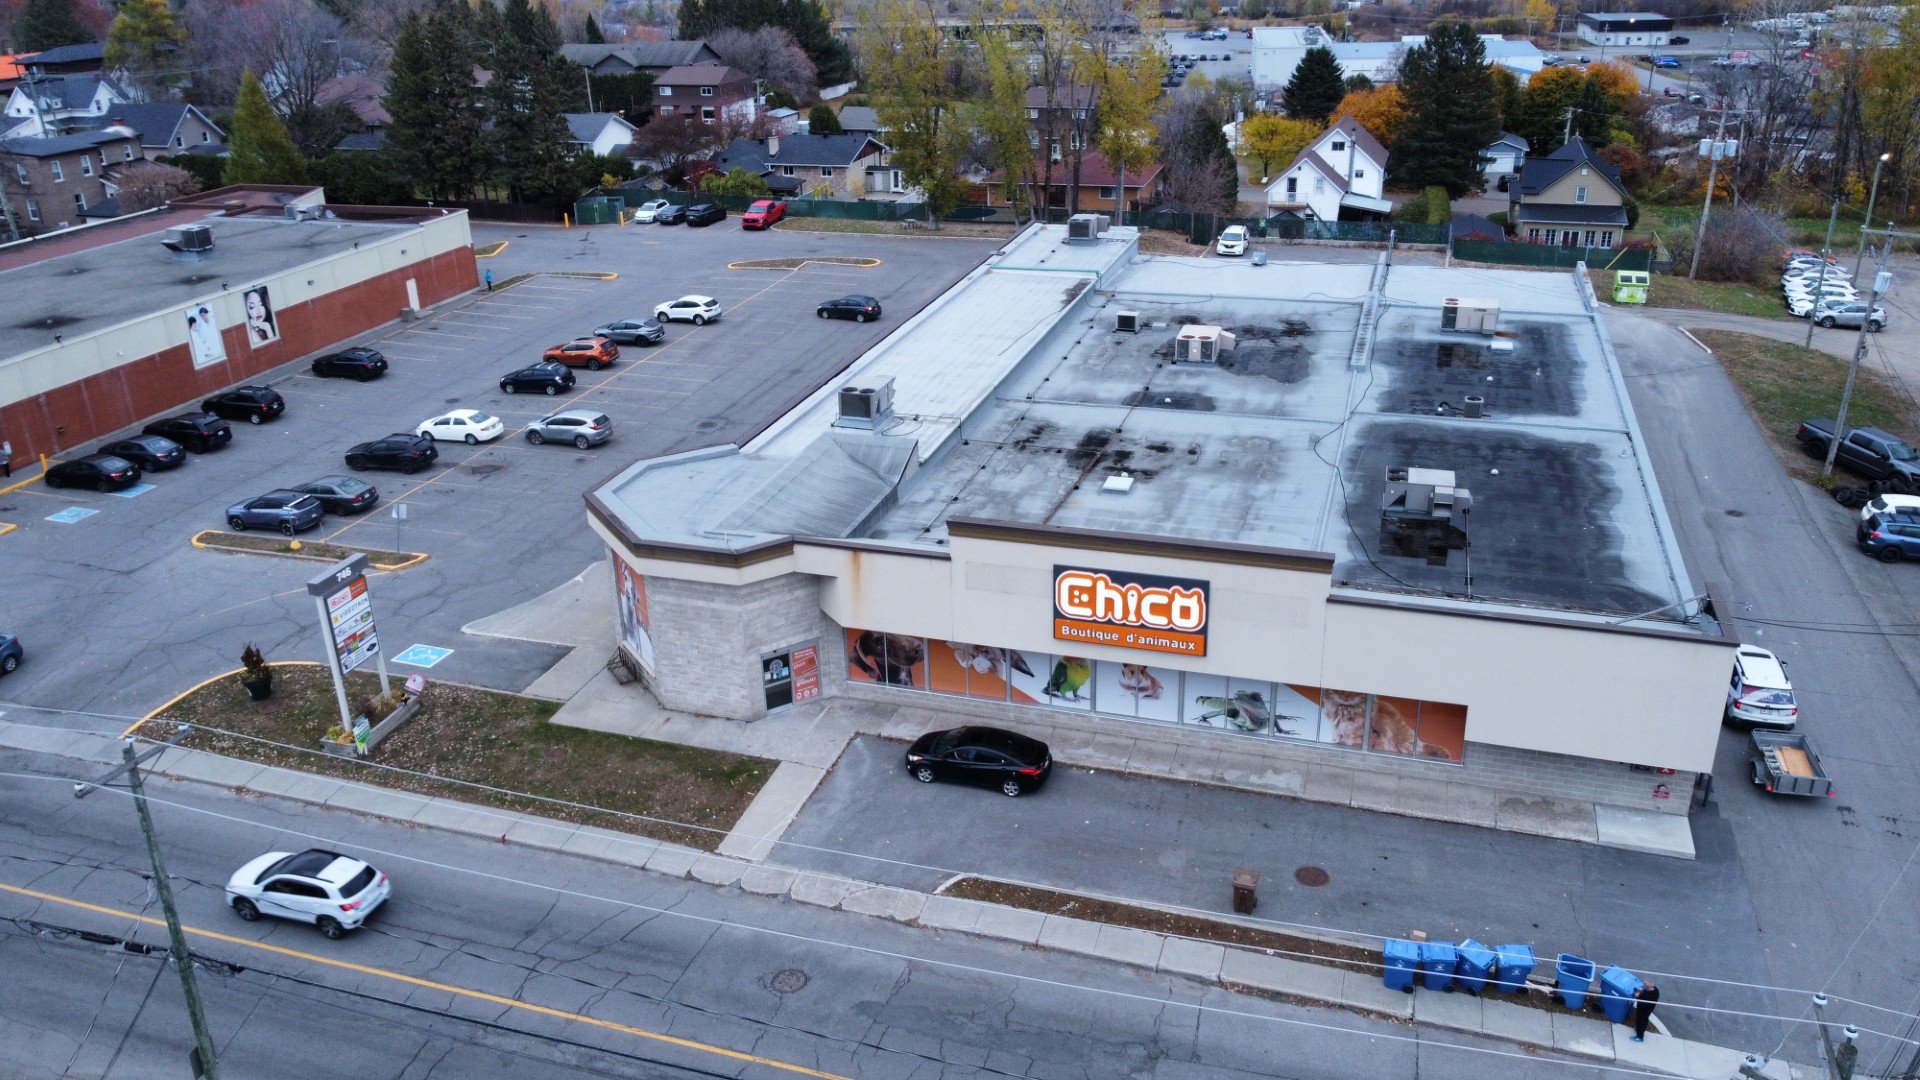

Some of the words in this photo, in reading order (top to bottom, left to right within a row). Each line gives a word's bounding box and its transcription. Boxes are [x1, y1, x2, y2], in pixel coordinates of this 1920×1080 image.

[336, 567, 352, 582] 746
[1059, 574, 1201, 629] Chico
[1061, 625, 1119, 641] Boutique
[1126, 633, 1196, 650] d'animaux
